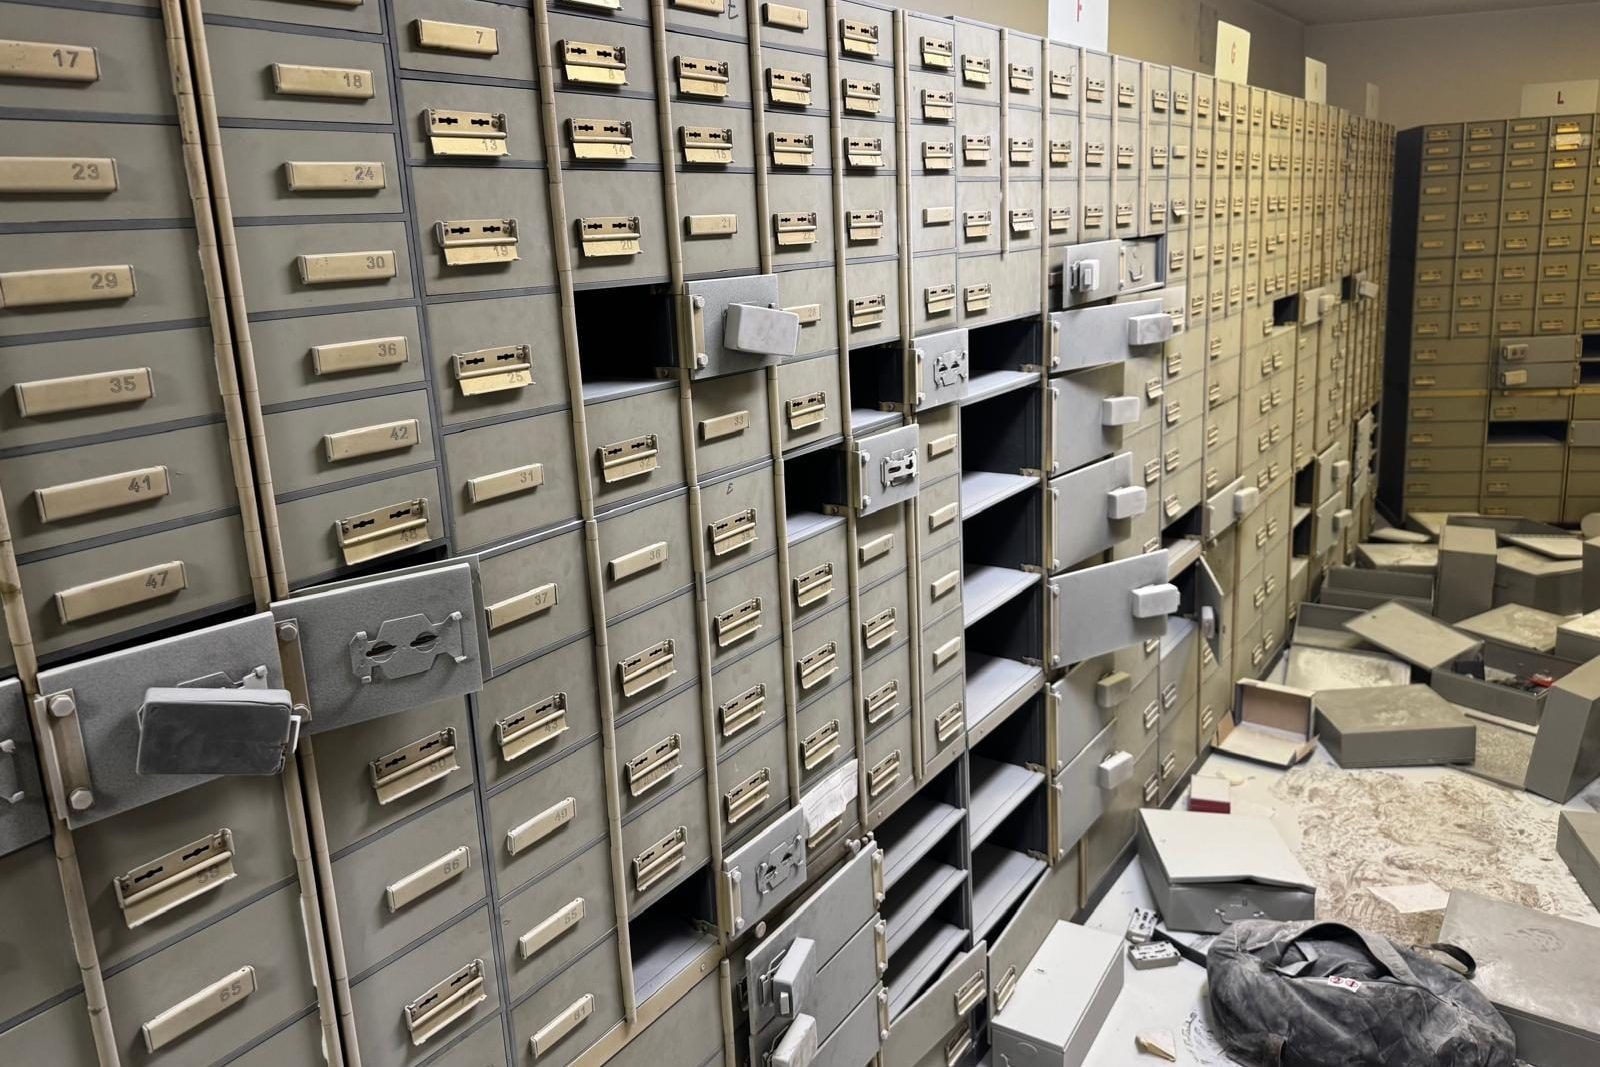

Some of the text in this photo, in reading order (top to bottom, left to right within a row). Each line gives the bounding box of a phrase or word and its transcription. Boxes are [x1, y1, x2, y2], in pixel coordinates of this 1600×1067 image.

[476, 31, 484, 44] 7
[53, 49, 79, 68] 17
[343, 73, 363, 88] 18
[1557, 90, 1564, 104] L
[481, 138, 498, 151] 13
[72, 163, 100, 180] 23
[355, 166, 375, 181] 24
[493, 245, 509, 257] 19
[366, 256, 385, 269] 30
[90, 273, 118, 289] 29
[378, 343, 397, 357] 36
[506, 371, 524, 383] 25
[110, 376, 137, 394] 35
[390, 427, 409, 441] 42
[128, 476, 151, 493] 41
[520, 472, 535, 485] 31
[146, 570, 169, 589] 47
[535, 592, 548, 605] 37
[220, 980, 242, 1002] 65
